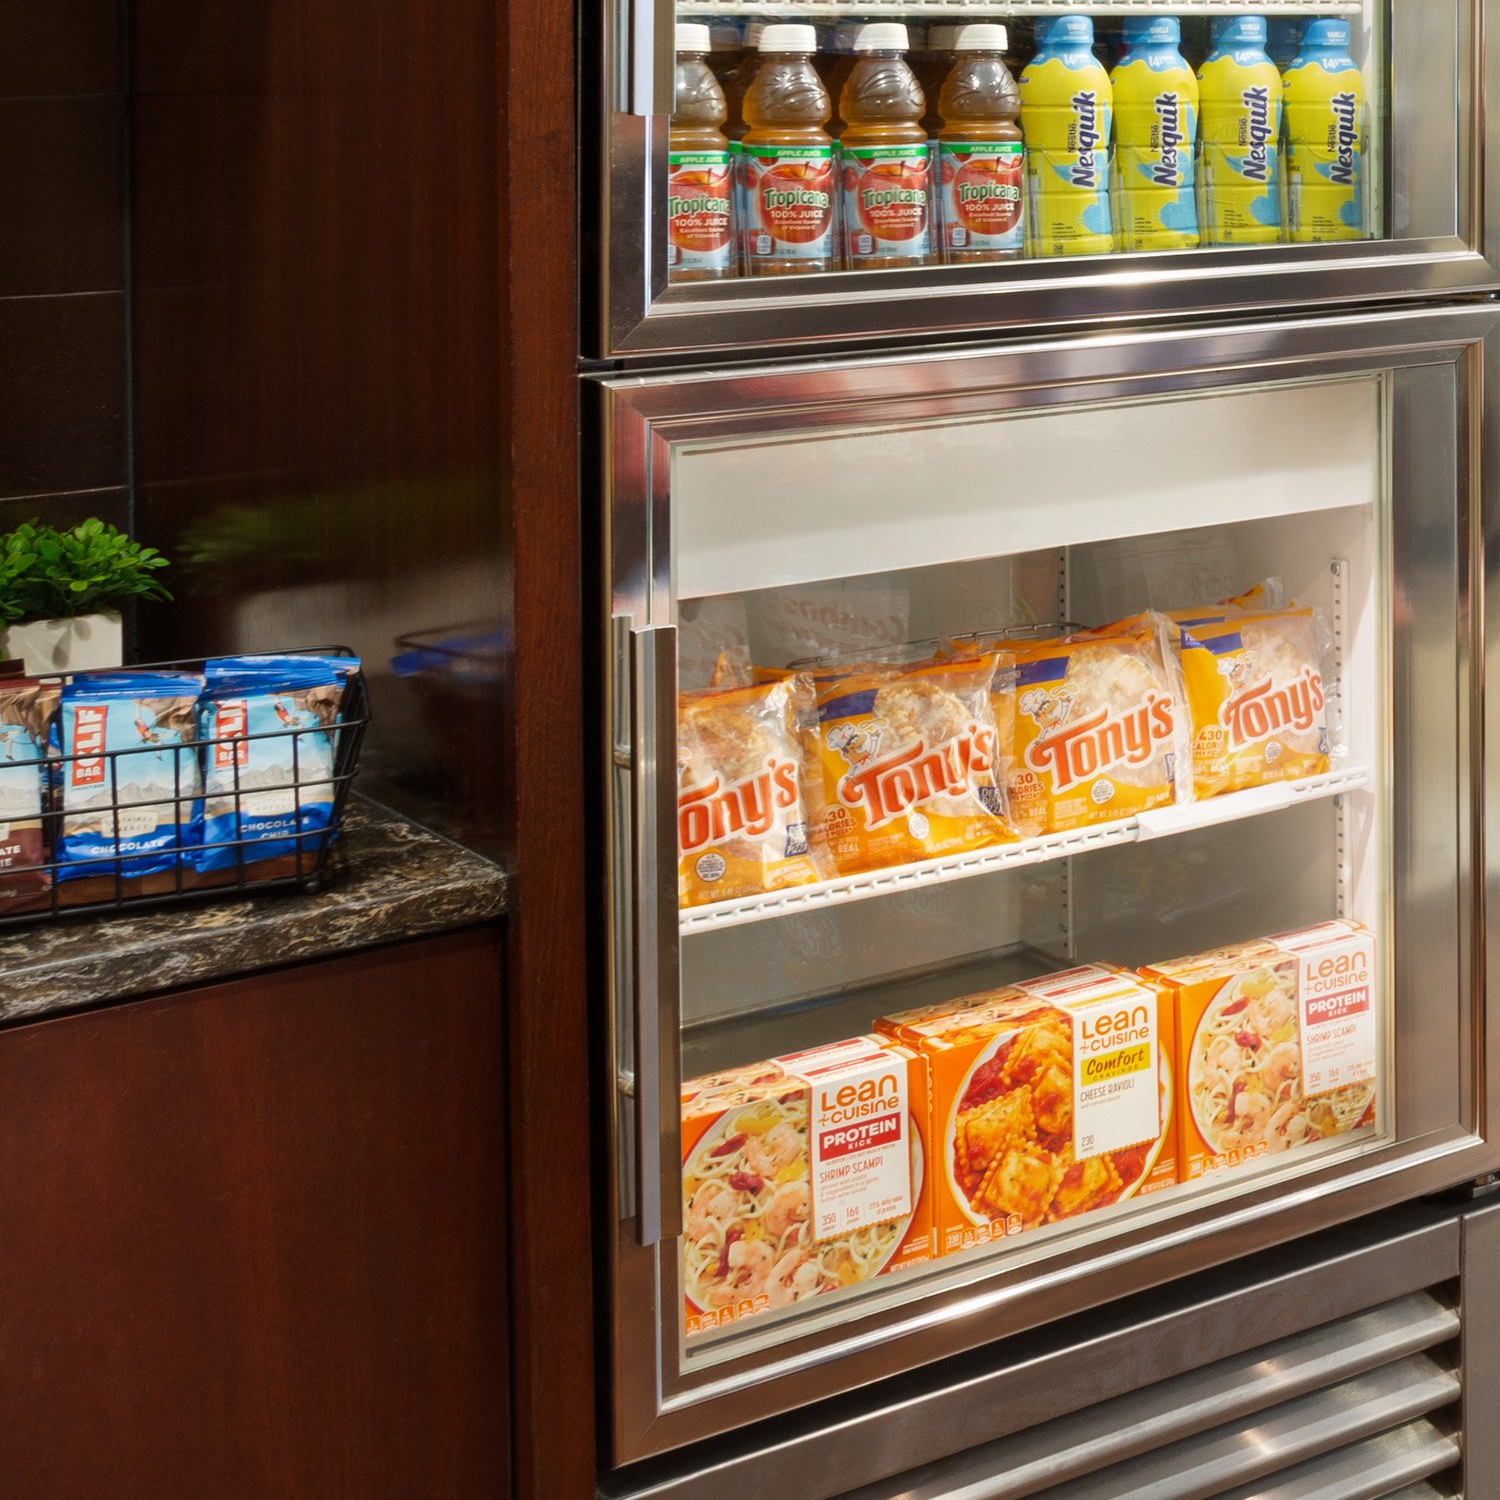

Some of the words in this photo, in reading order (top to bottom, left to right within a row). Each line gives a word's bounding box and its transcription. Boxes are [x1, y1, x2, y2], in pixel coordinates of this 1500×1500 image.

[1071, 92, 1100, 188] Nesquik
[1153, 93, 1183, 186] Nesquik
[1242, 86, 1272, 181] Nesquik
[1330, 93, 1358, 185] Nesquik
[763, 186, 828, 209] Tropicana
[861, 186, 926, 209] Tropicana
[958, 181, 1019, 204] Tropicana
[771, 210, 797, 218] 100%
[799, 210, 824, 218] JUICE
[992, 203, 1015, 211] JUICE
[1223, 668, 1324, 749] Tony's
[1029, 693, 1173, 789] Tony's
[76, 768, 101, 778] BAR
[840, 725, 993, 827] Tony's
[1306, 951, 1366, 981] Lean
[1308, 990, 1366, 1015] PROTEIN
[1328, 1007, 1347, 1017] KICK
[1082, 1005, 1148, 1040] Lean
[1307, 1032, 1331, 1046] SHRIMP
[1086, 1049, 1144, 1076] Comfort
[1093, 1065, 1139, 1081] CRAVINGS
[821, 1074, 898, 1111] Lean
[1080, 1087, 1106, 1102] CHEESE
[1108, 1078, 1135, 1095] RAVIOLI
[824, 1118, 896, 1149] PROTEIN
[848, 1138, 872, 1150] KICK
[820, 1165, 850, 1184] SHRIMP
[853, 1155, 883, 1175] SCAMPI
